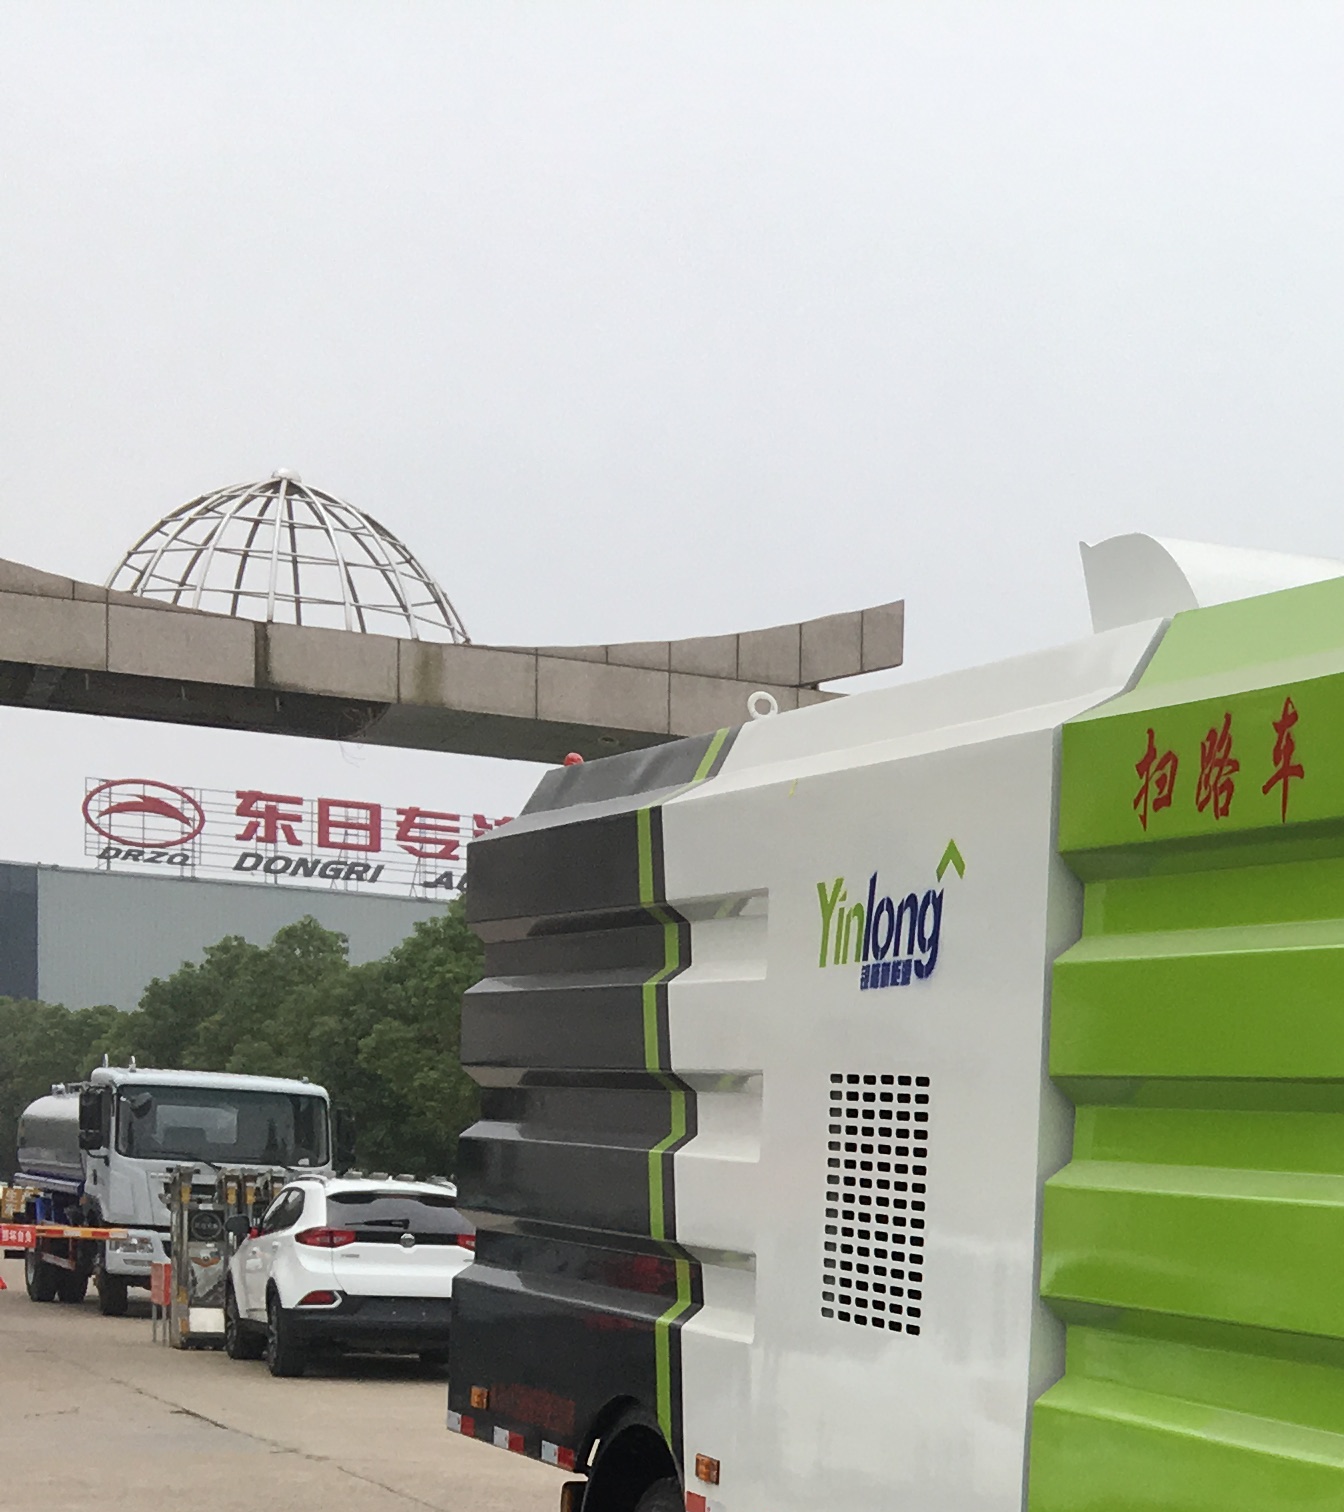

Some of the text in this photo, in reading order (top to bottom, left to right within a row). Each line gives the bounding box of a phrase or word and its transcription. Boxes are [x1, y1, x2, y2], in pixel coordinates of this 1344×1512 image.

[1133, 696, 1305, 832] 扫路车
[96, 846, 194, 866] DRZQ
[233, 852, 385, 884] DONGRI
[816, 870, 944, 979] Yinlong
